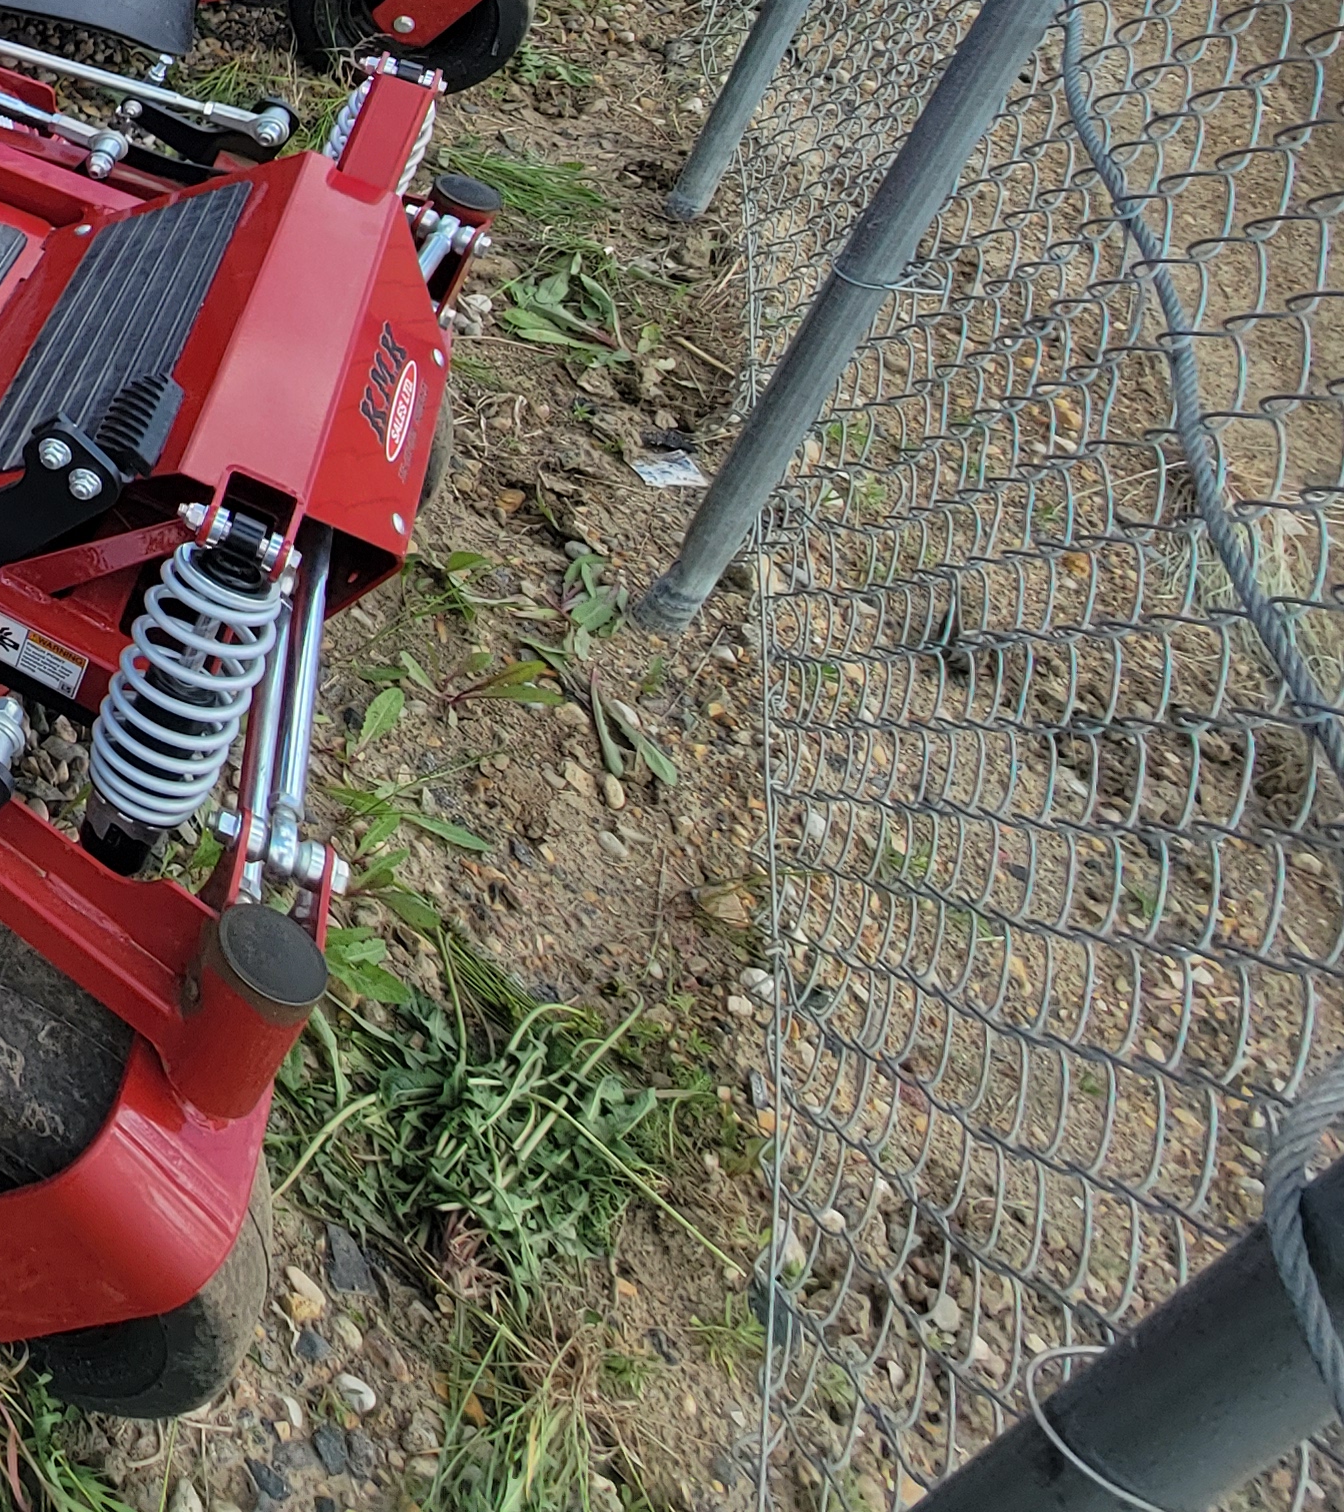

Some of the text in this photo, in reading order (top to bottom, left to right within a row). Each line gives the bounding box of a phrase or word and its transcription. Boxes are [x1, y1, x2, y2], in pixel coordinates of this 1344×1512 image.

[359, 320, 407, 445] KMK
[391, 400, 408, 445] SALES
[37, 636, 83, 666] WARNING
